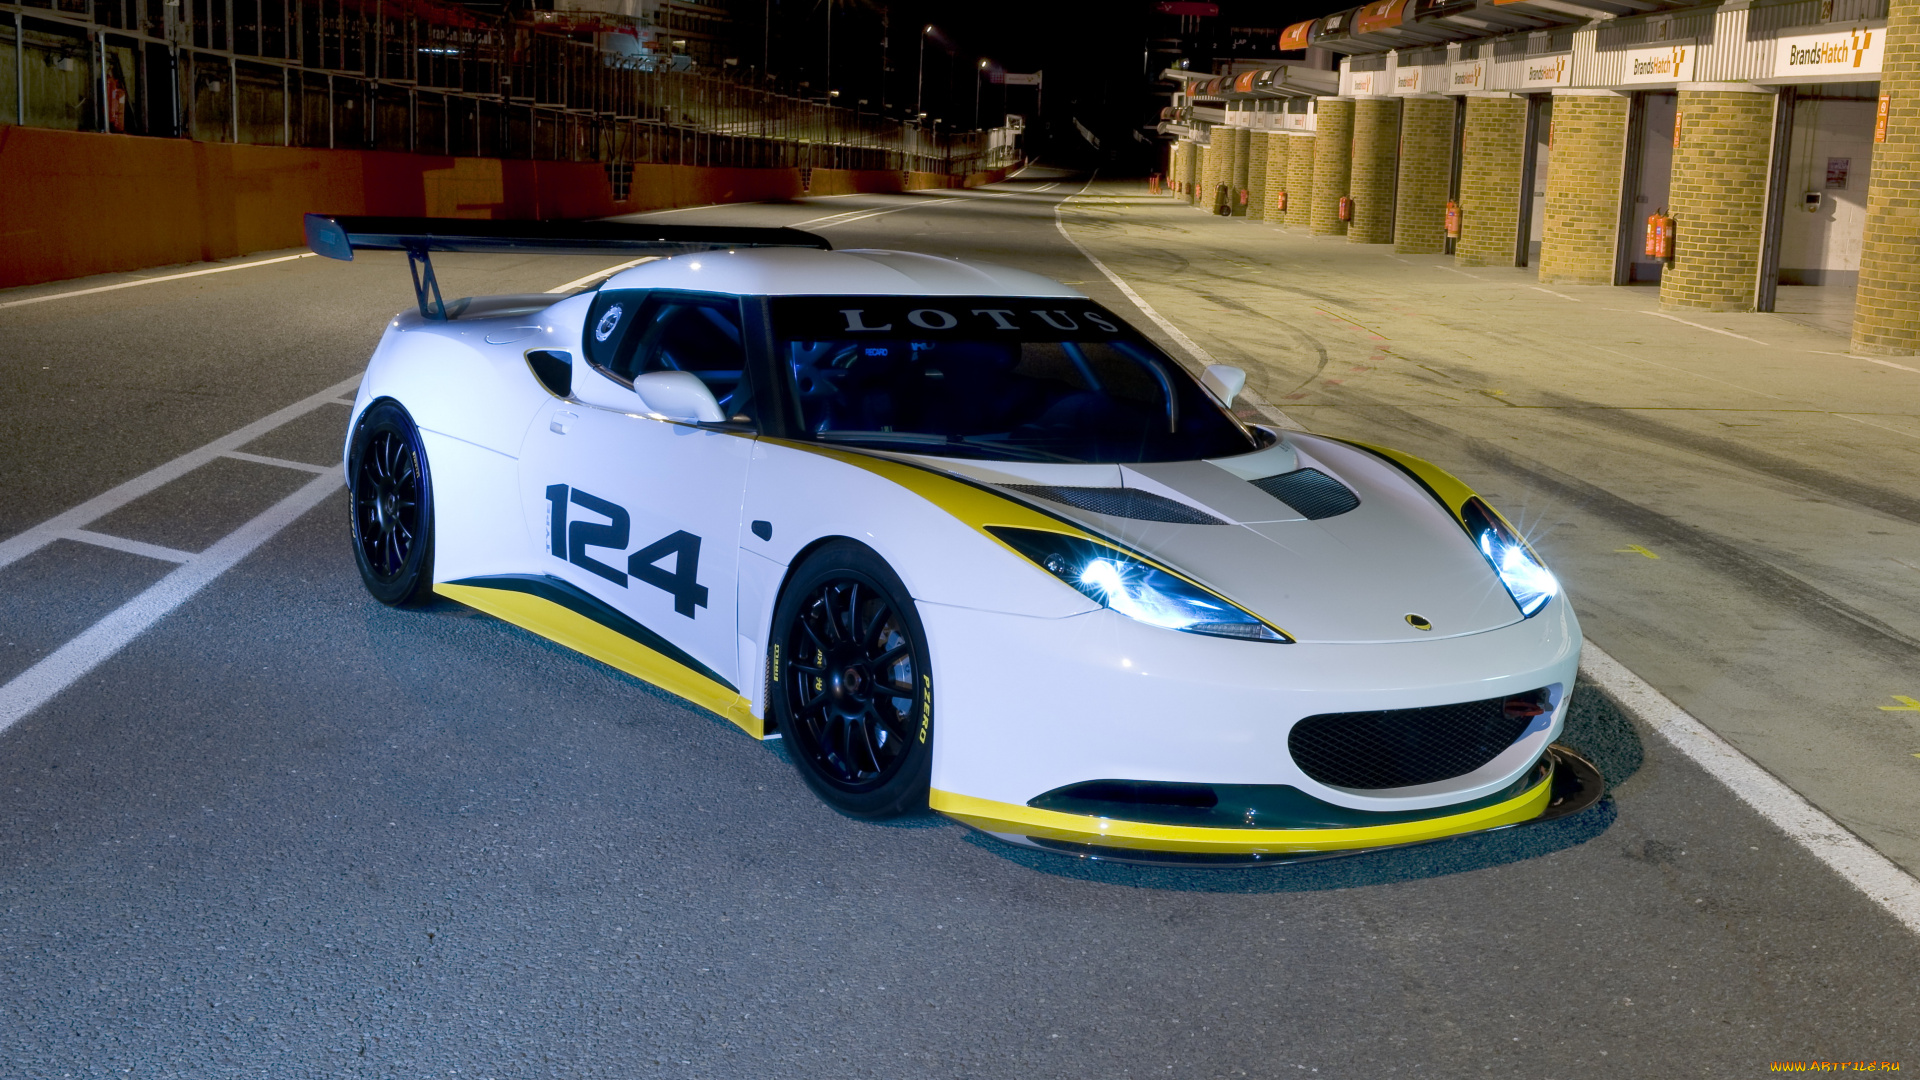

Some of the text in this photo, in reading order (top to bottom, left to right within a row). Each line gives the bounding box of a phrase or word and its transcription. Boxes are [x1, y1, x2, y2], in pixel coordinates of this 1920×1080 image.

[1633, 55, 1671, 76] BrandsHatch
[1789, 40, 1848, 66] BrandsHatch
[839, 308, 1119, 333] LOTUS
[865, 348, 888, 357] RECARO
[546, 484, 709, 620] 124
[919, 674, 931, 744] PZERO
